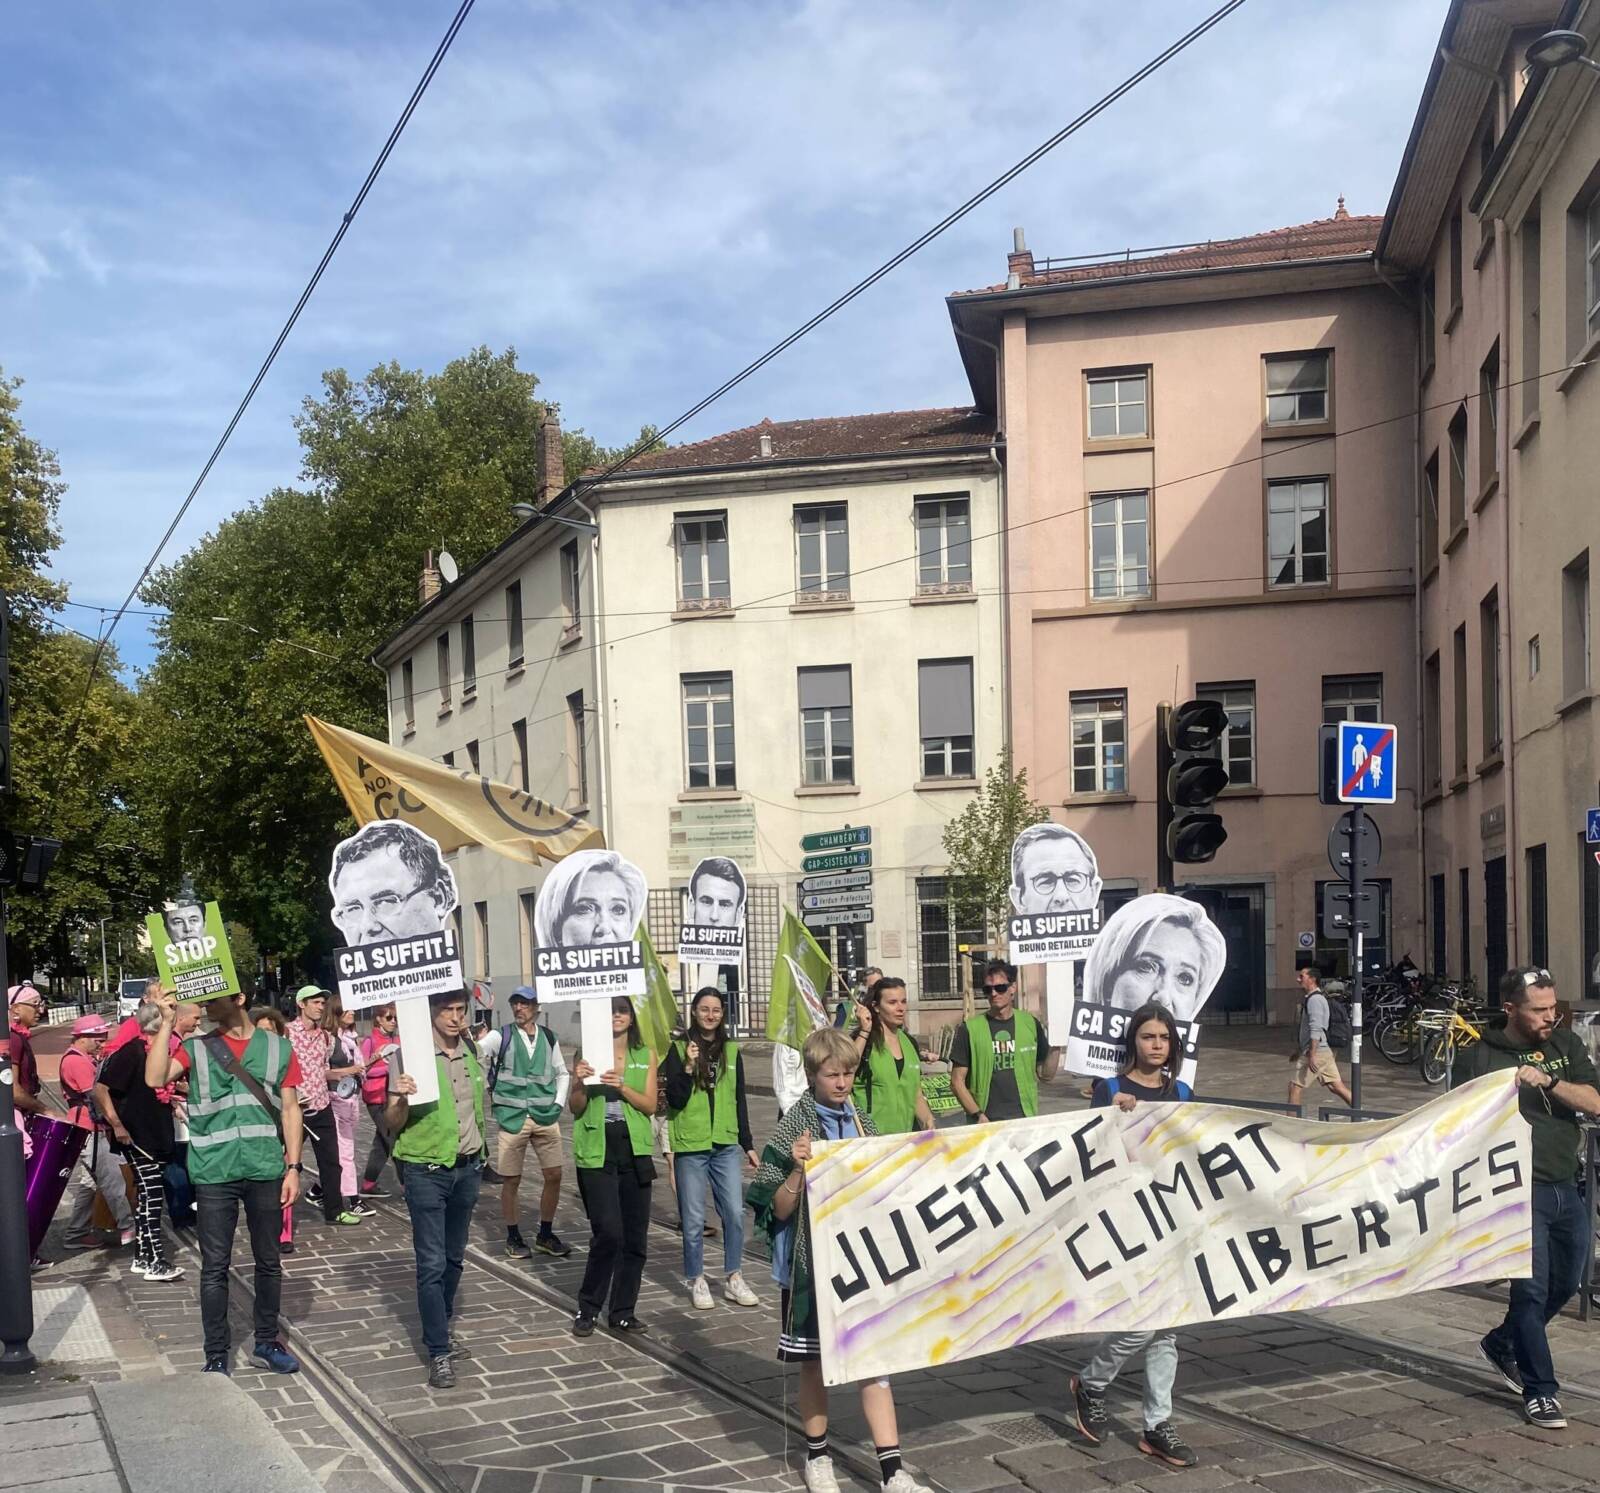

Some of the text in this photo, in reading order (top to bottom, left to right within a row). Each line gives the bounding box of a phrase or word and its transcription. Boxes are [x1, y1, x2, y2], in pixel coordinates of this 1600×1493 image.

[820, 832, 857, 846] CHAMBÉRY
[808, 854, 858, 870] GAP-SISTERON
[1012, 908, 1100, 939] ÇA SUFFIT!
[682, 926, 742, 944] ÇA SUFFIT!
[164, 936, 217, 966] STOP
[340, 929, 454, 978] ÇA SUFFIT!
[680, 946, 740, 956] EMMANUEL MACRON
[1018, 938, 1096, 952] BRUNO RETAILLEA
[538, 940, 640, 974] ÇA SUFFIT!
[178, 978, 213, 990] POLLUEURS
[352, 976, 397, 995] PATRICK
[554, 972, 628, 989] MARINE LE PEN
[176, 983, 228, 1001] EXTRÊME DROITE
[390, 988, 410, 998] chaos
[411, 982, 447, 993] climatique
[554, 988, 604, 996] Rassemblement
[1076, 1008, 1104, 1035] ÇA
[1088, 1045, 1126, 1064] MARIN
[831, 1114, 1117, 1302] JUSTICE
[1064, 1122, 1282, 1282] CLIMAT
[1194, 1140, 1524, 1316] LIBERTES
